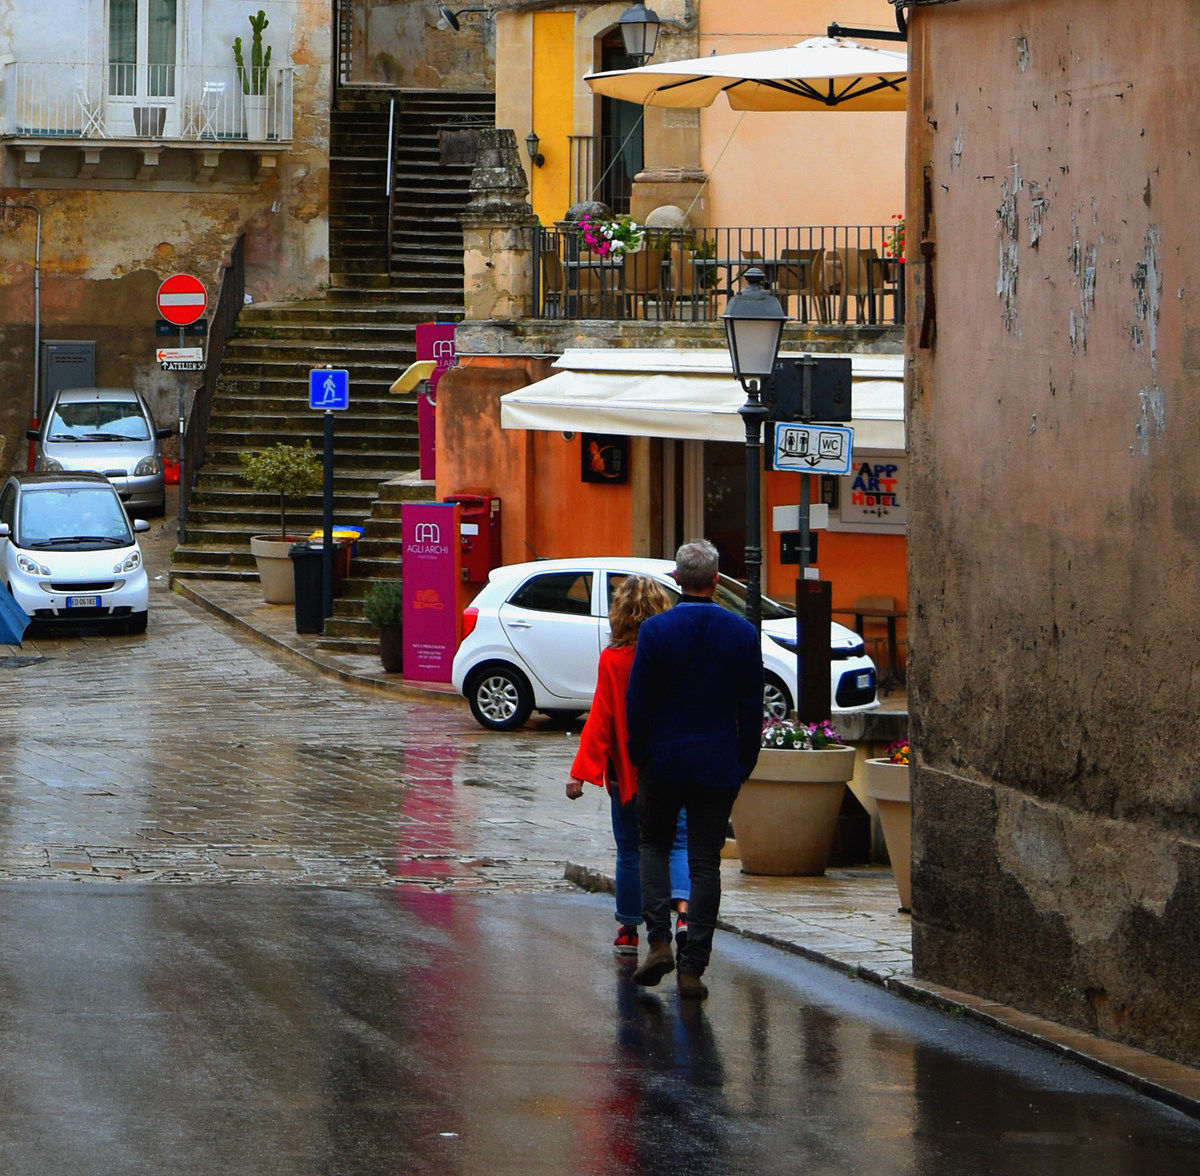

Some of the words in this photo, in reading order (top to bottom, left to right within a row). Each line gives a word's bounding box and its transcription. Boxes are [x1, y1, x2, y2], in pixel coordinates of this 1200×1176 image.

[168, 362, 197, 371] ATELIER
[822, 438, 839, 451] WC
[851, 475, 898, 493] ART
[407, 544, 424, 554] AGLI
[424, 545, 449, 555] ARCHI
